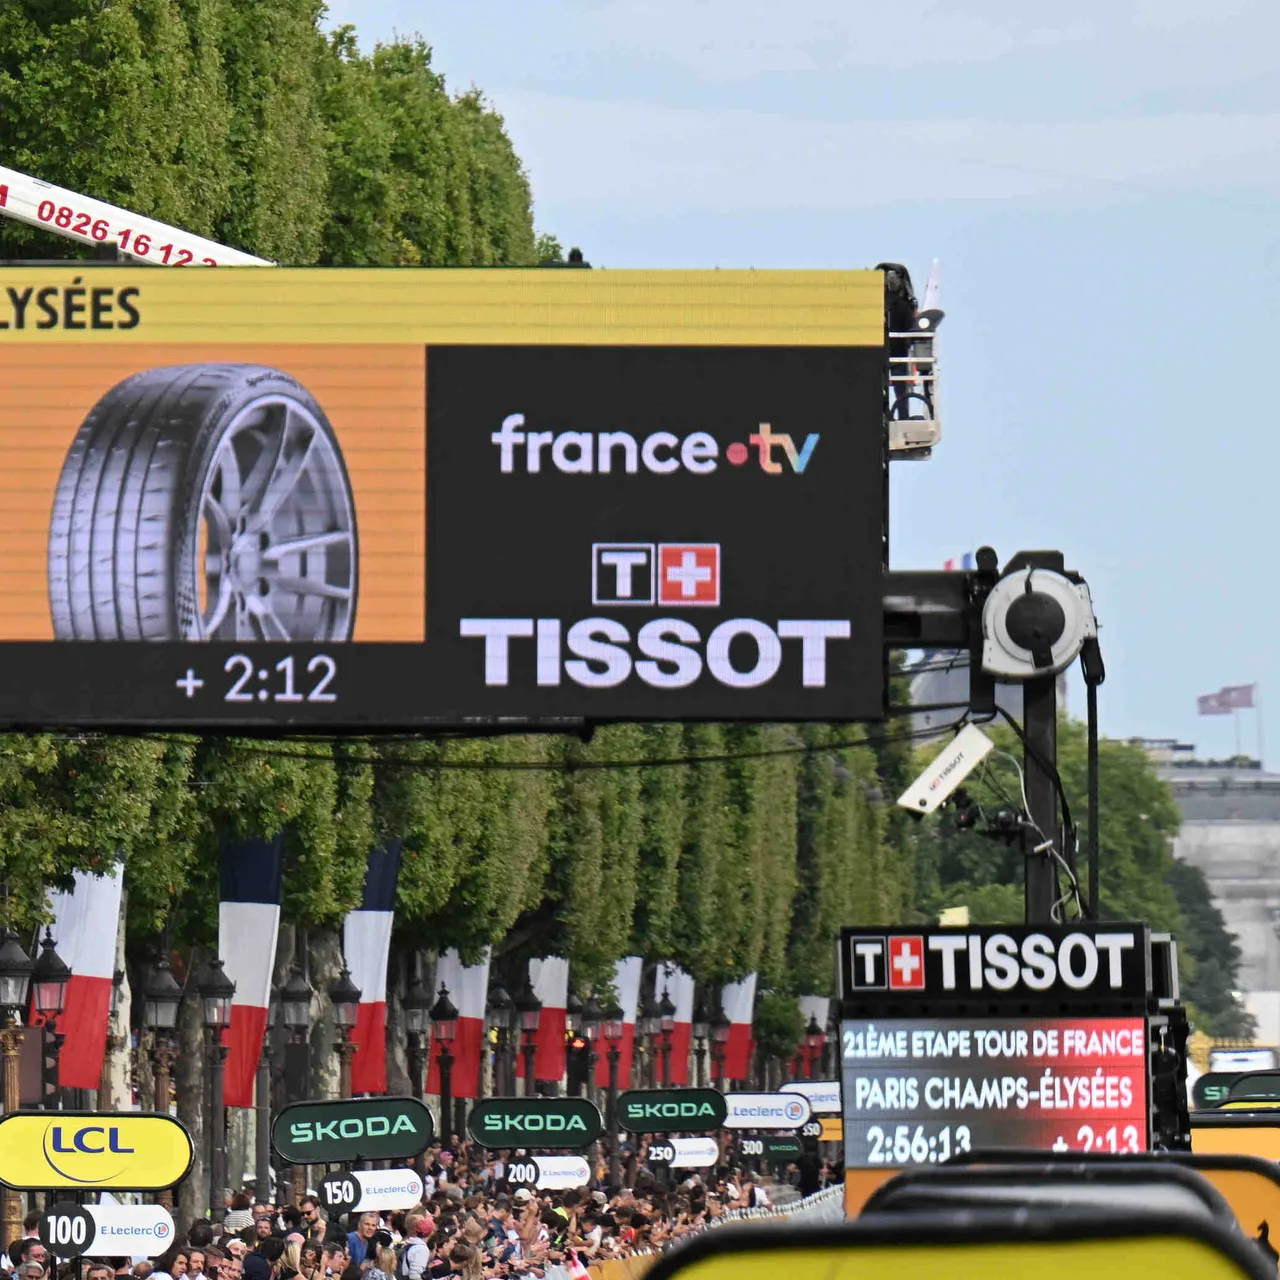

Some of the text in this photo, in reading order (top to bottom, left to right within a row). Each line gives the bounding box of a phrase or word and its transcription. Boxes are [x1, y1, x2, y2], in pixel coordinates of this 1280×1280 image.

[37, 198, 109, 241] 0826
[118, 228, 152, 257] 16
[459, 618, 850, 689] TISSOT
[223, 656, 338, 703] 2:12
[928, 932, 1135, 990] TISSOT
[843, 1024, 1144, 1059] 21ÈME ETAPE TOUR DE FRANCE
[806, 1092, 838, 1102] clerc
[855, 1068, 1133, 1110] PARIS CHAMPS-ÉLYSÉES
[484, 1113, 587, 1132] SKODA
[627, 1102, 716, 1118] SKODA
[728, 1105, 783, 1117] .Leclerc
[51, 1126, 135, 1154] LCL
[290, 1113, 417, 1144] SKODA
[649, 1146, 673, 1161] 250
[507, 1163, 536, 1184] 200
[324, 1180, 407, 1205] 150 E.Leclerc
[47, 1215, 154, 1245] 100 E.Leclerc
